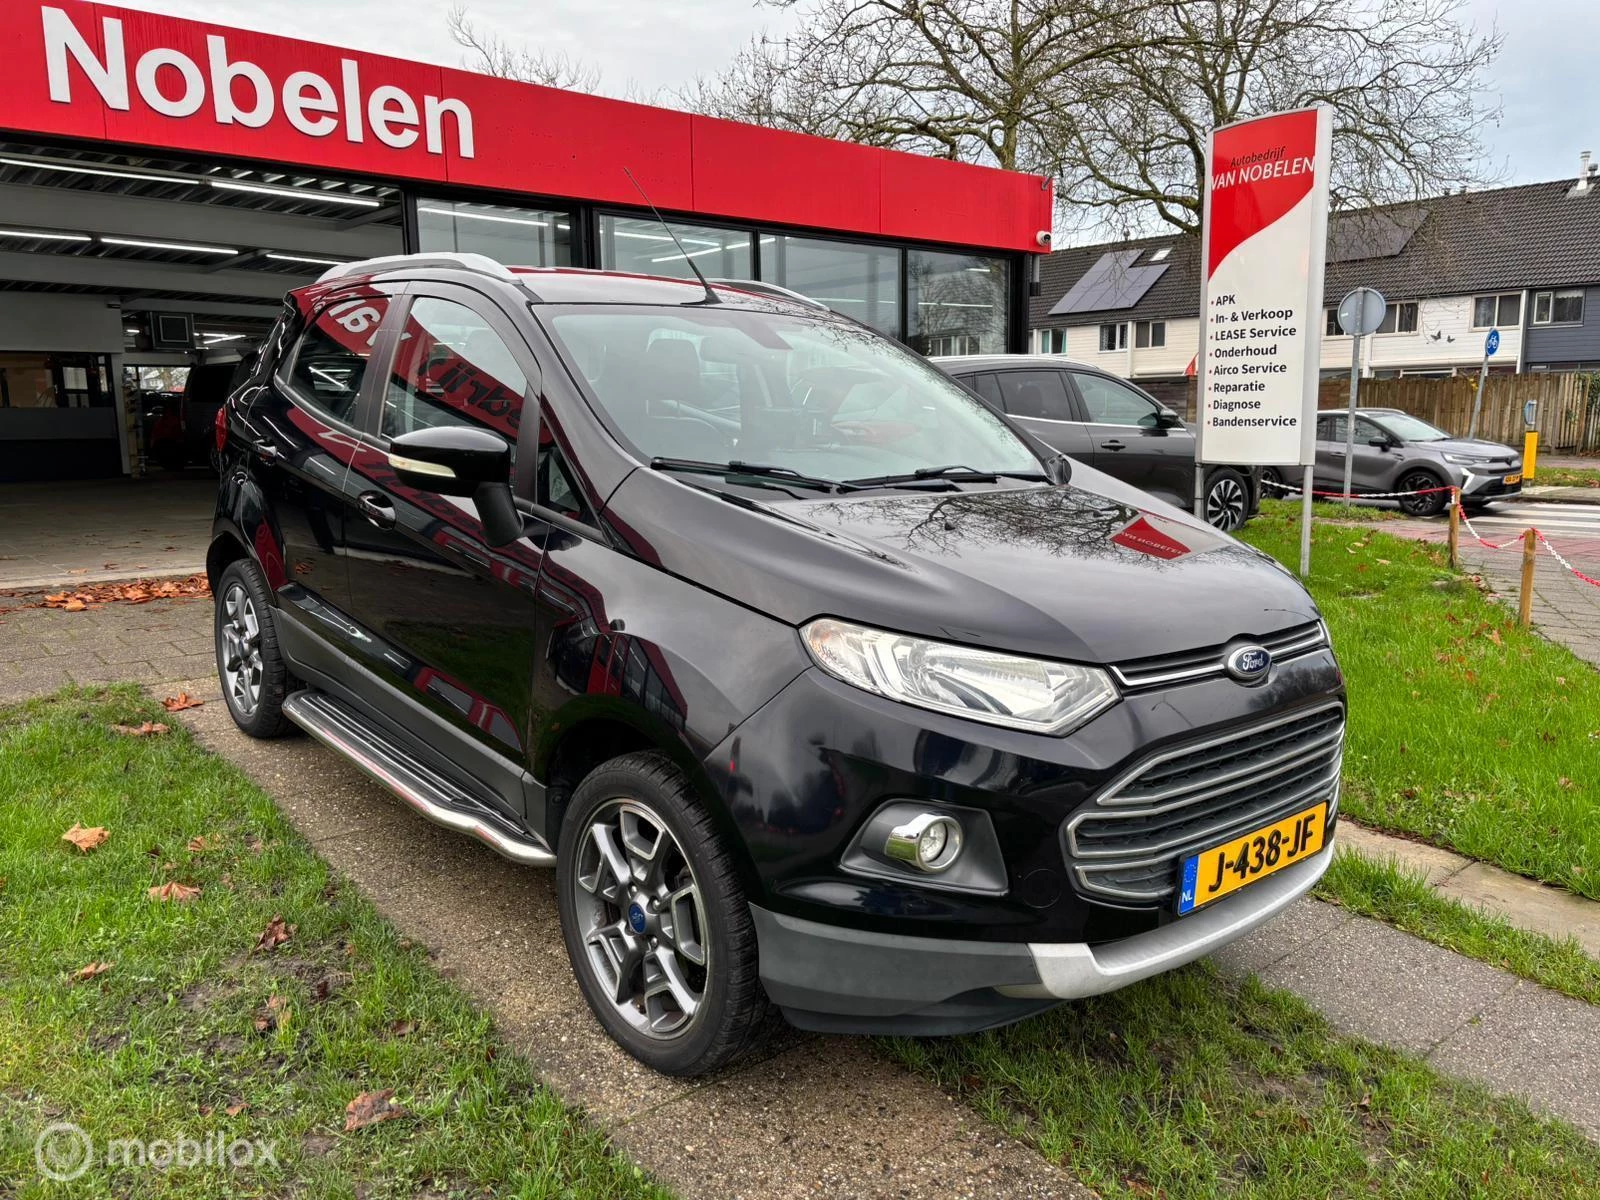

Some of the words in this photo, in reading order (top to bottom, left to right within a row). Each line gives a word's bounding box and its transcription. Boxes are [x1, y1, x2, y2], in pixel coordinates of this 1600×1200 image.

[42, 5, 475, 159] Nobelen
[1230, 146, 1286, 168] Autobedrijf
[1211, 169, 1236, 191] VAN
[1238, 156, 1315, 184] NOBELEN
[1215, 294, 1236, 306] APK
[1215, 314, 1229, 324] In-
[1230, 312, 1239, 322] &
[1241, 308, 1293, 321] Verkoop
[1215, 328, 1247, 341] LEASE
[1249, 325, 1297, 338] Service
[1214, 344, 1277, 358] Onderhoud
[1213, 364, 1239, 376] Airco
[1241, 362, 1287, 374] Service
[1213, 380, 1265, 395] Reparatie
[1213, 399, 1261, 412] Diagnose
[1212, 415, 1297, 427] Bandenservice
[1242, 651, 1265, 671] Ford
[1208, 814, 1316, 893] J-438-JF
[1181, 890, 1193, 903] NL
